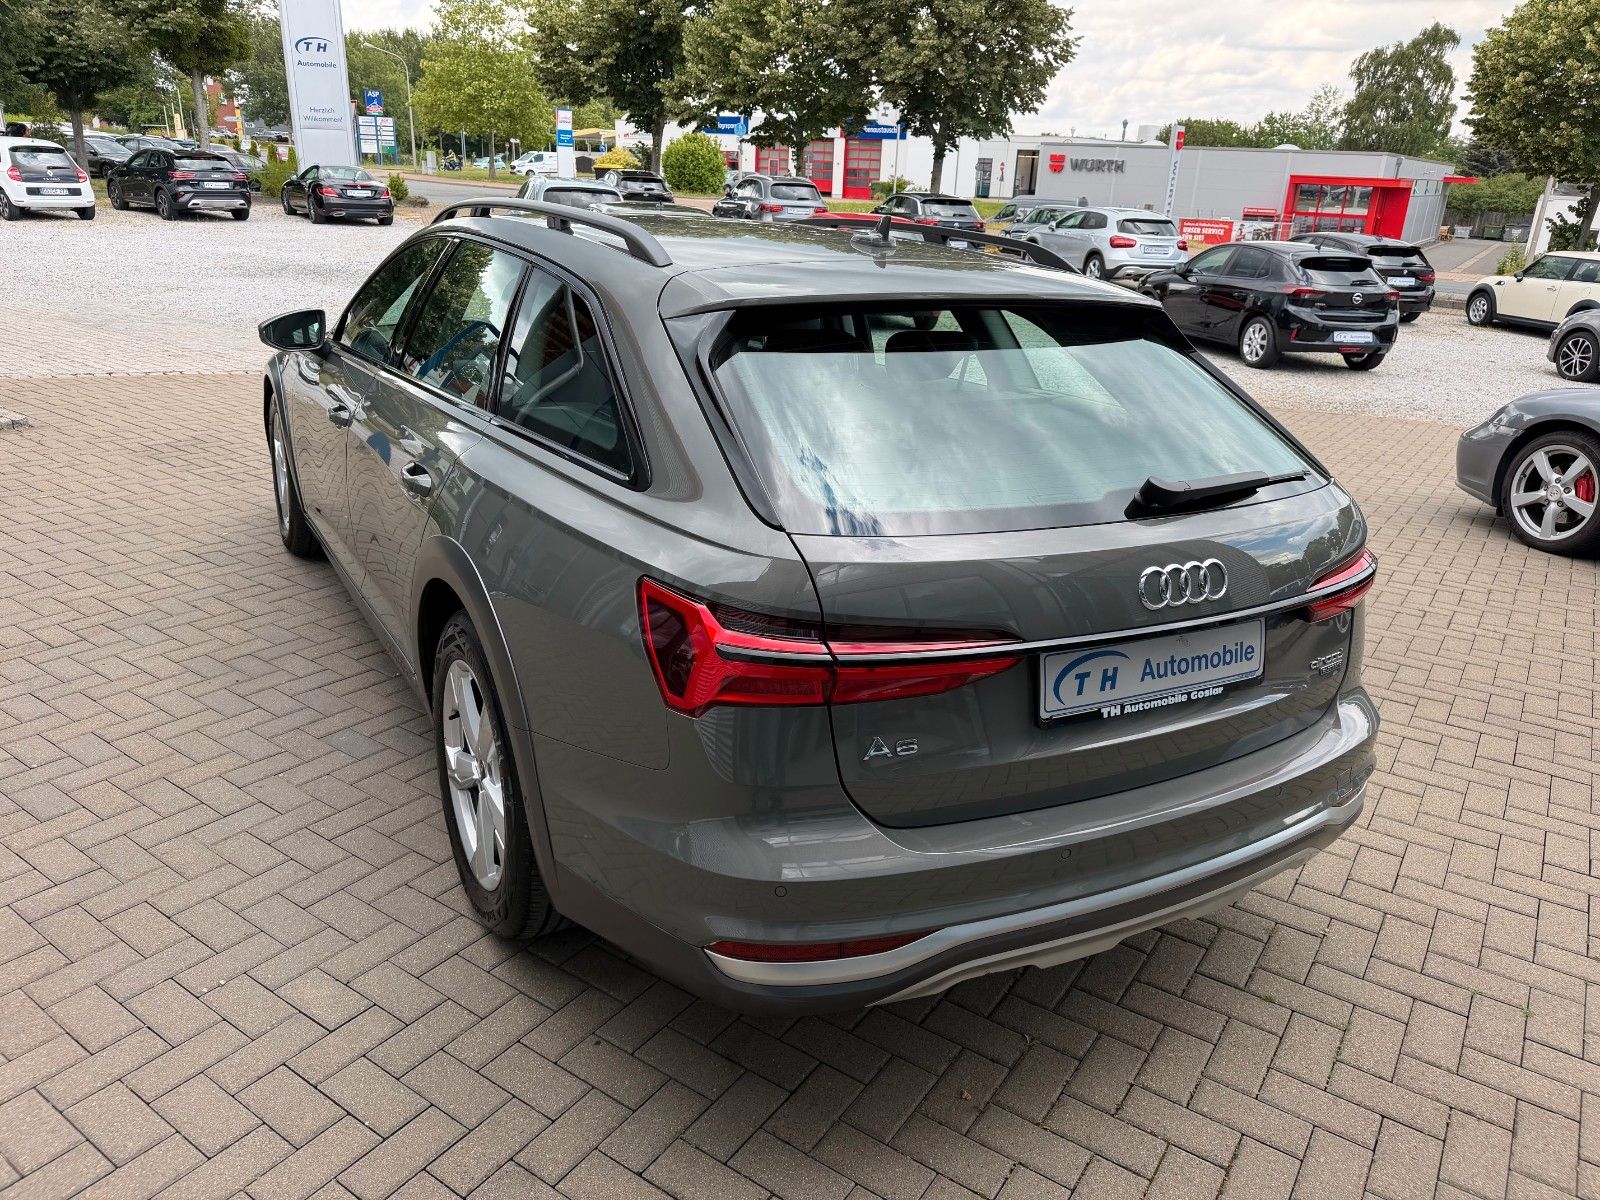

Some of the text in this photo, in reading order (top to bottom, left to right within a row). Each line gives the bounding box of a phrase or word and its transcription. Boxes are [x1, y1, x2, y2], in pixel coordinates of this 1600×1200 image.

[297, 60, 338, 69] Automobile
[309, 106, 335, 114] Herzlich
[1140, 641, 1255, 682] Automobile
[1101, 686, 1224, 718] TH Automobile Goslar
[863, 737, 918, 760] A6
